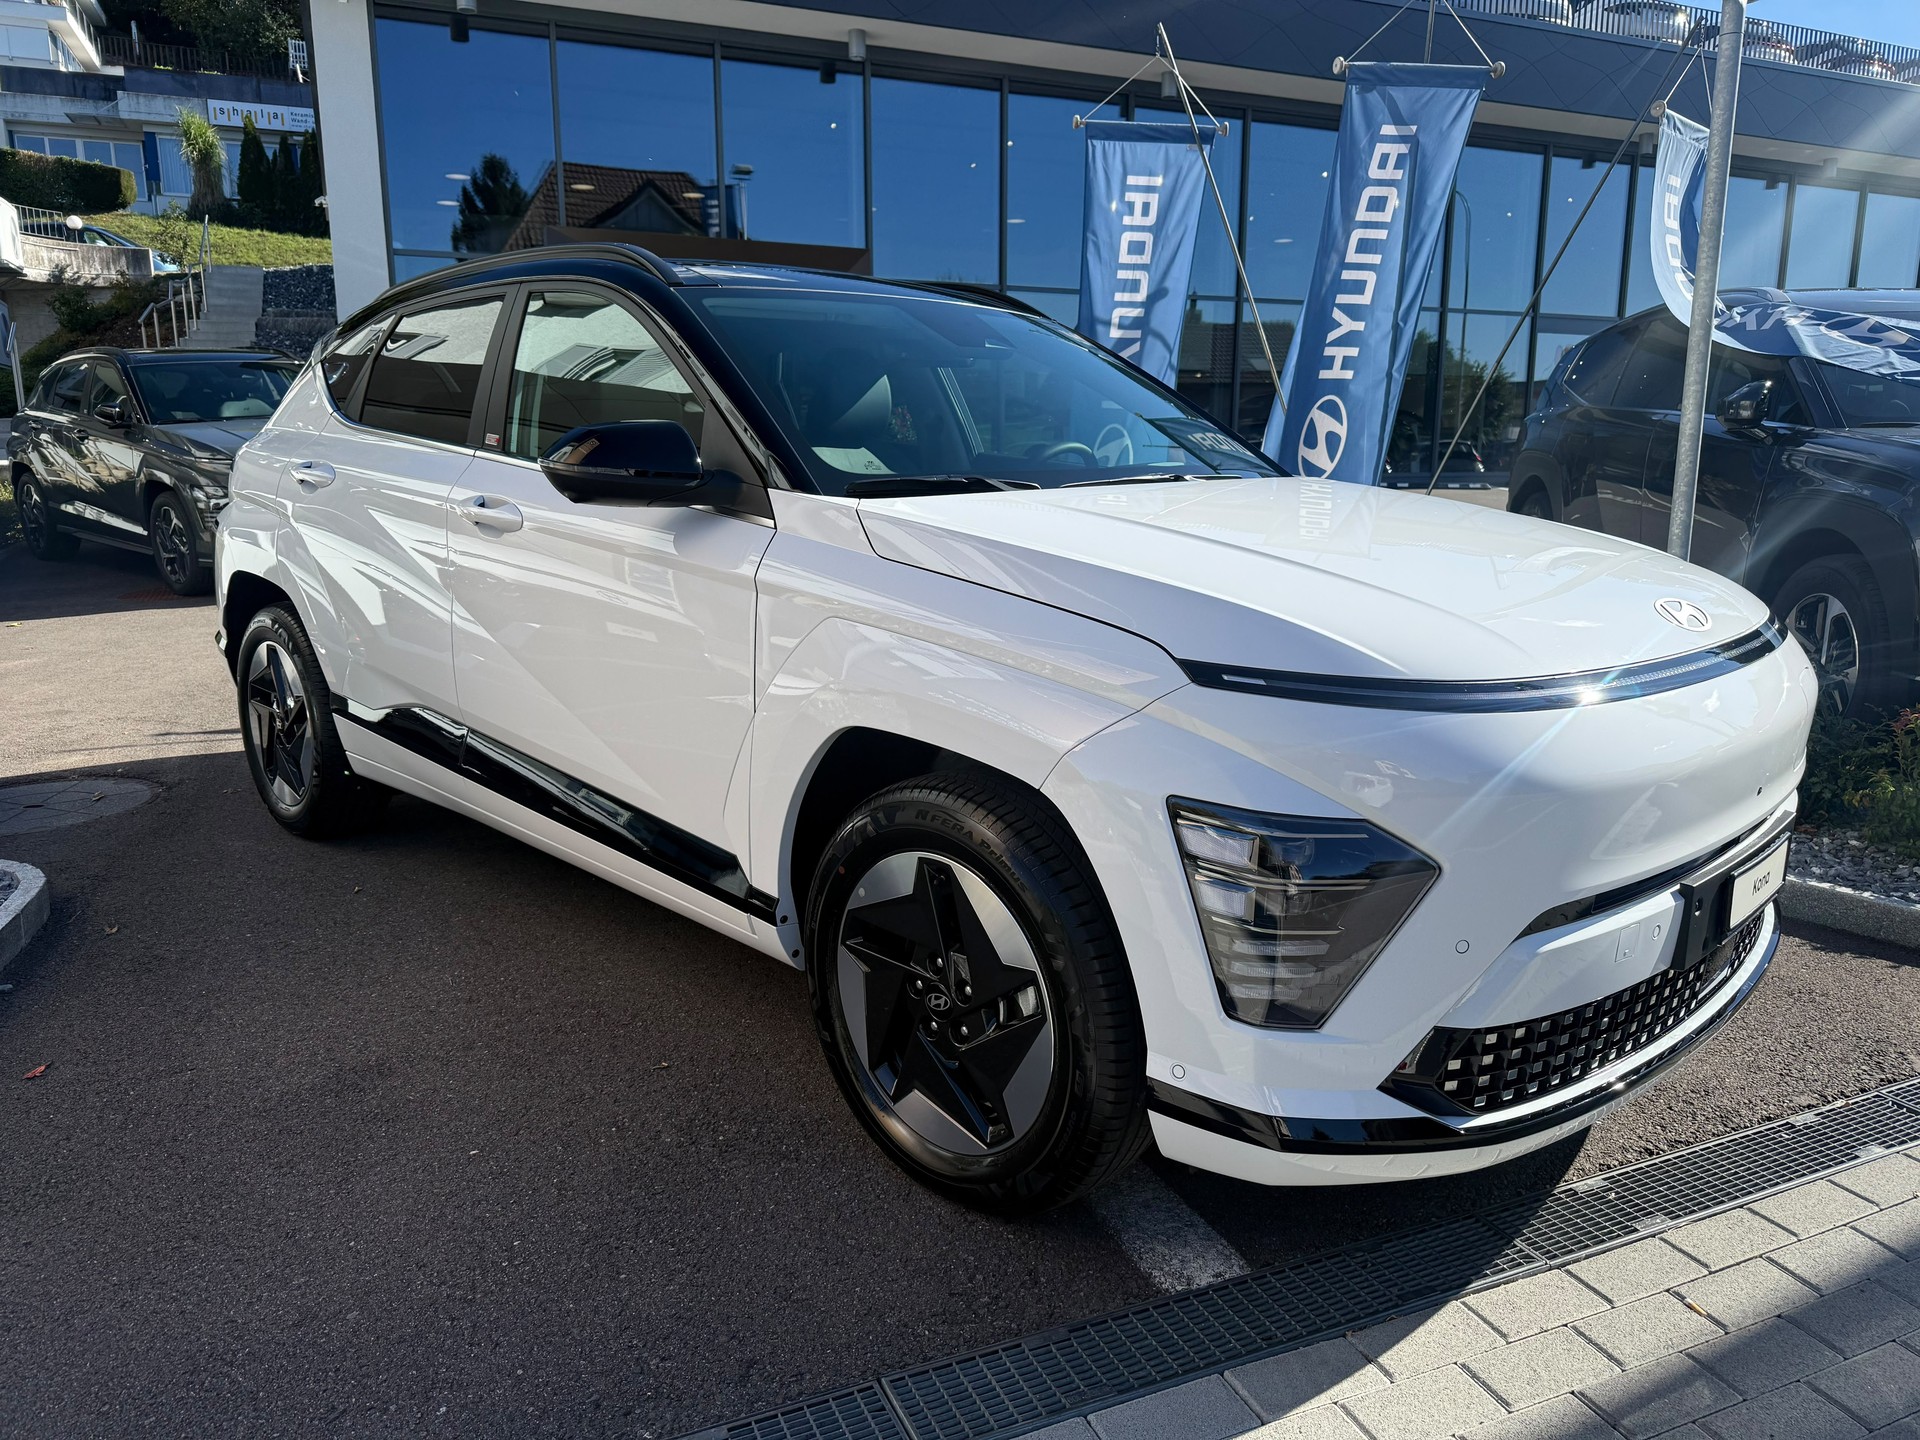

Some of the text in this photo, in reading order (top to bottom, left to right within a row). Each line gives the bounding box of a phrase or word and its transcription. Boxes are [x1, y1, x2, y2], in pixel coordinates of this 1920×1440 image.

[218, 106, 279, 121] shala
[1318, 124, 1418, 380] HYUNDAI
[977, 838, 1028, 893] Primus
[1752, 870, 1771, 896] Kona
